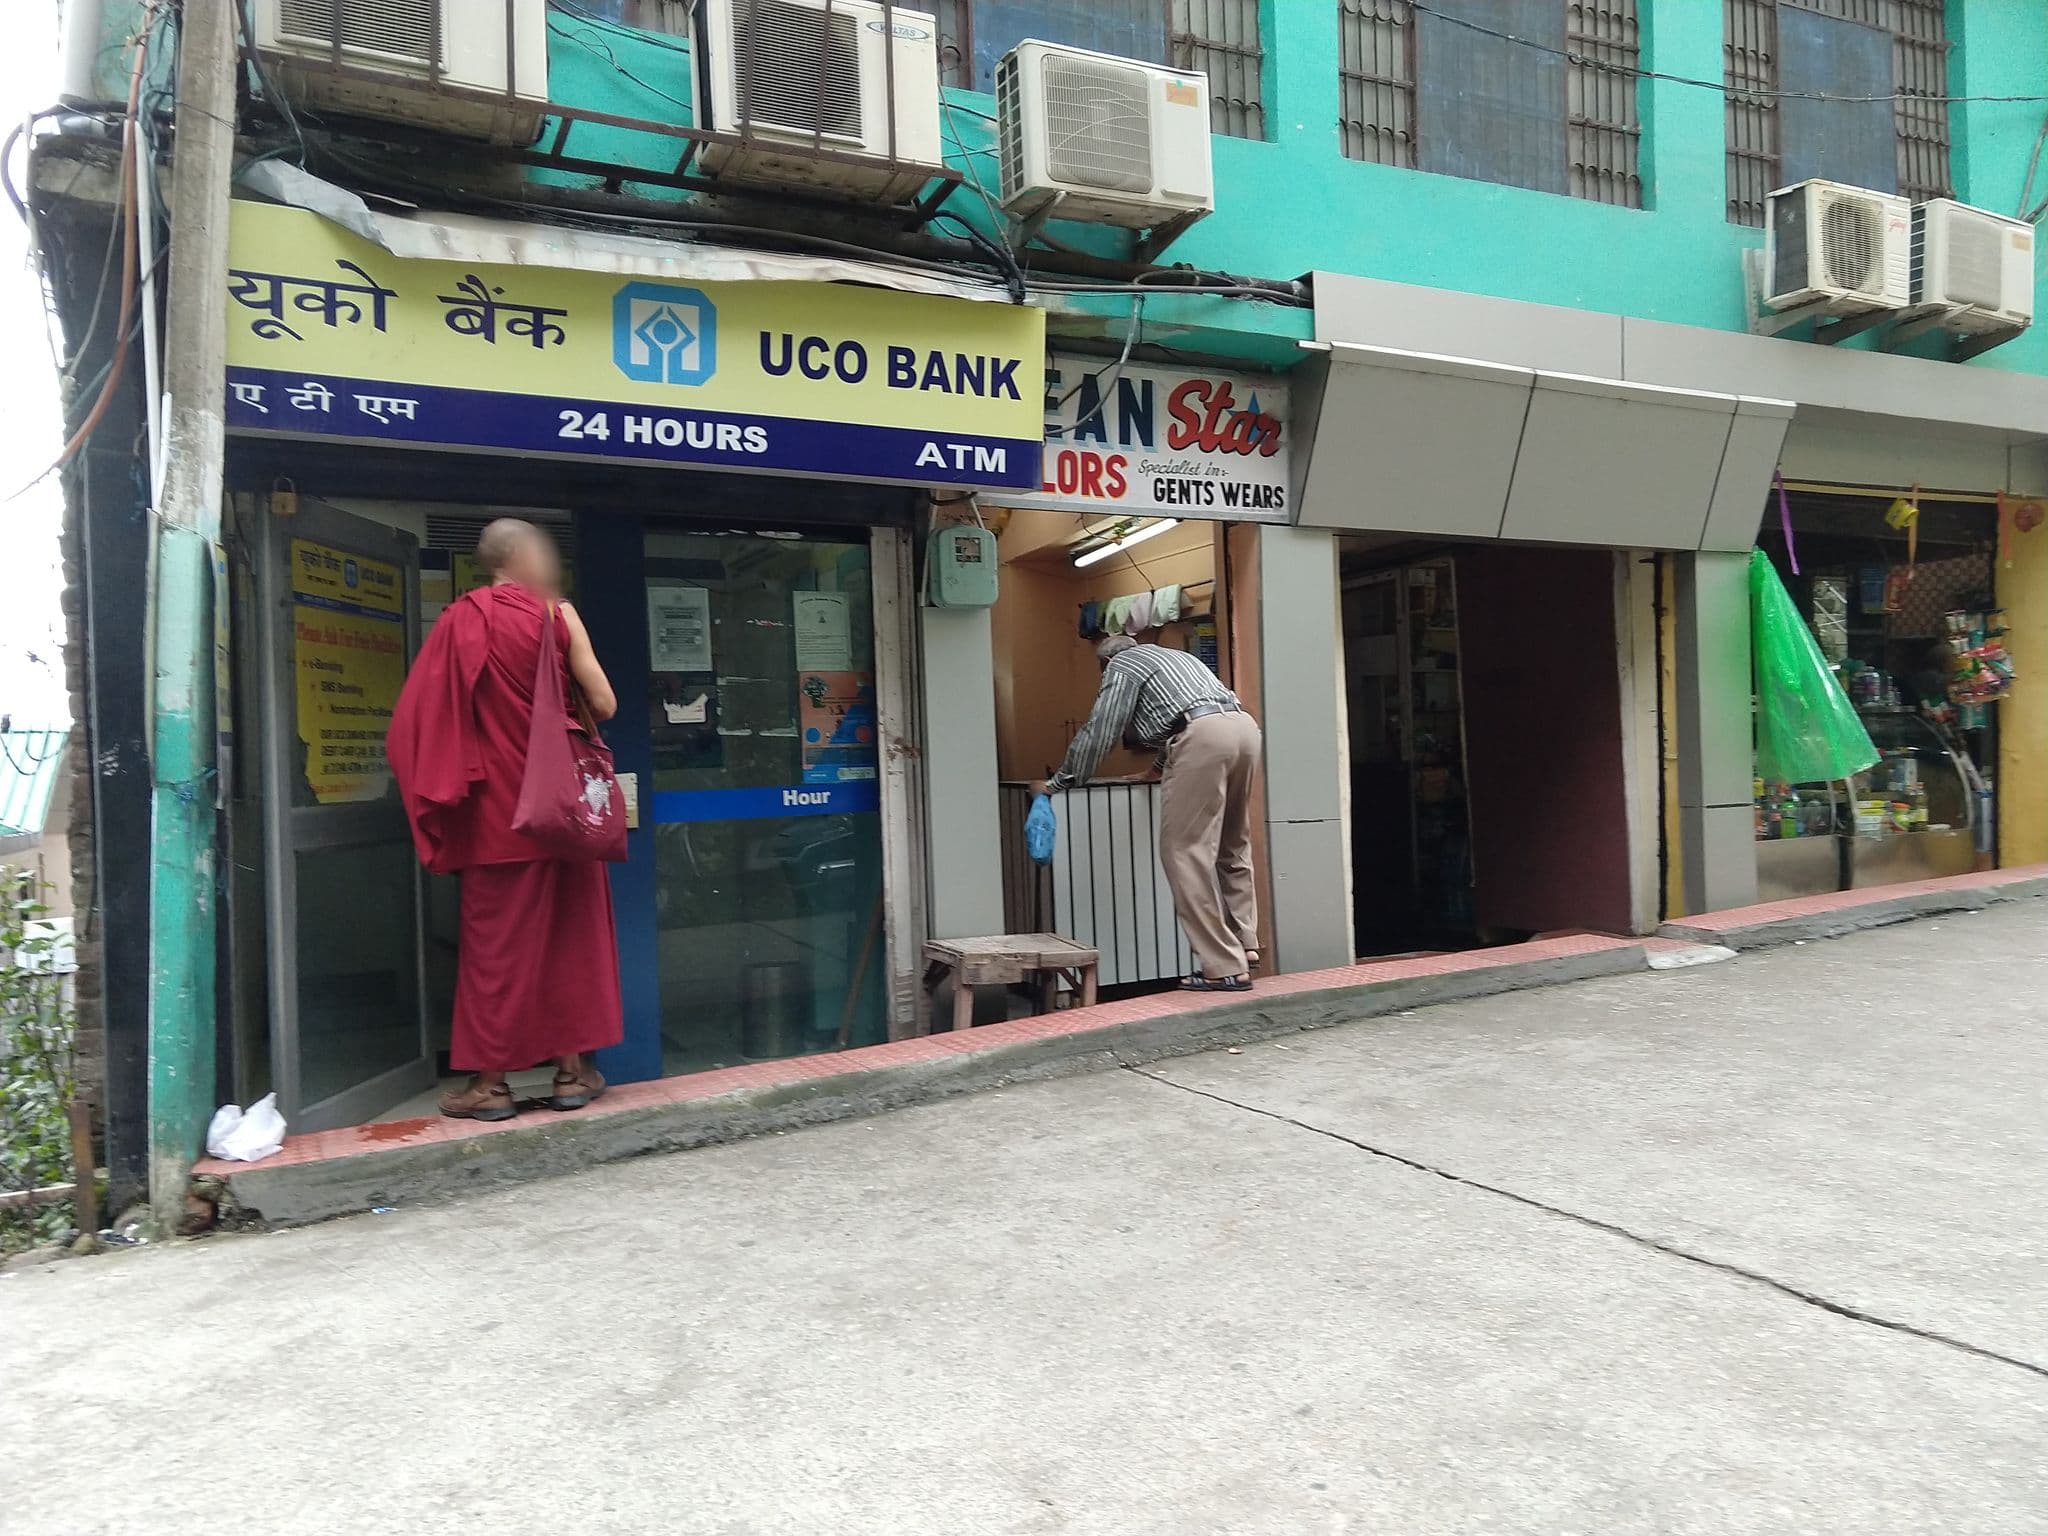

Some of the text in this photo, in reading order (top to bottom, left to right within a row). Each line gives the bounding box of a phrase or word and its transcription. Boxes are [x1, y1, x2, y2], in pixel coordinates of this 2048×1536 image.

[228, 259, 568, 350] यूको बैंक
[759, 331, 1023, 401] UCO BANK
[228, 382, 419, 424] ए टी एम
[1168, 379, 1282, 458] Star
[558, 410, 769, 454] 24 HOURS
[914, 442, 1007, 474] ATM
[1138, 459, 1201, 477] Specialist
[1153, 477, 1285, 509] GENTS WEARS
[782, 789, 832, 807] Hour
